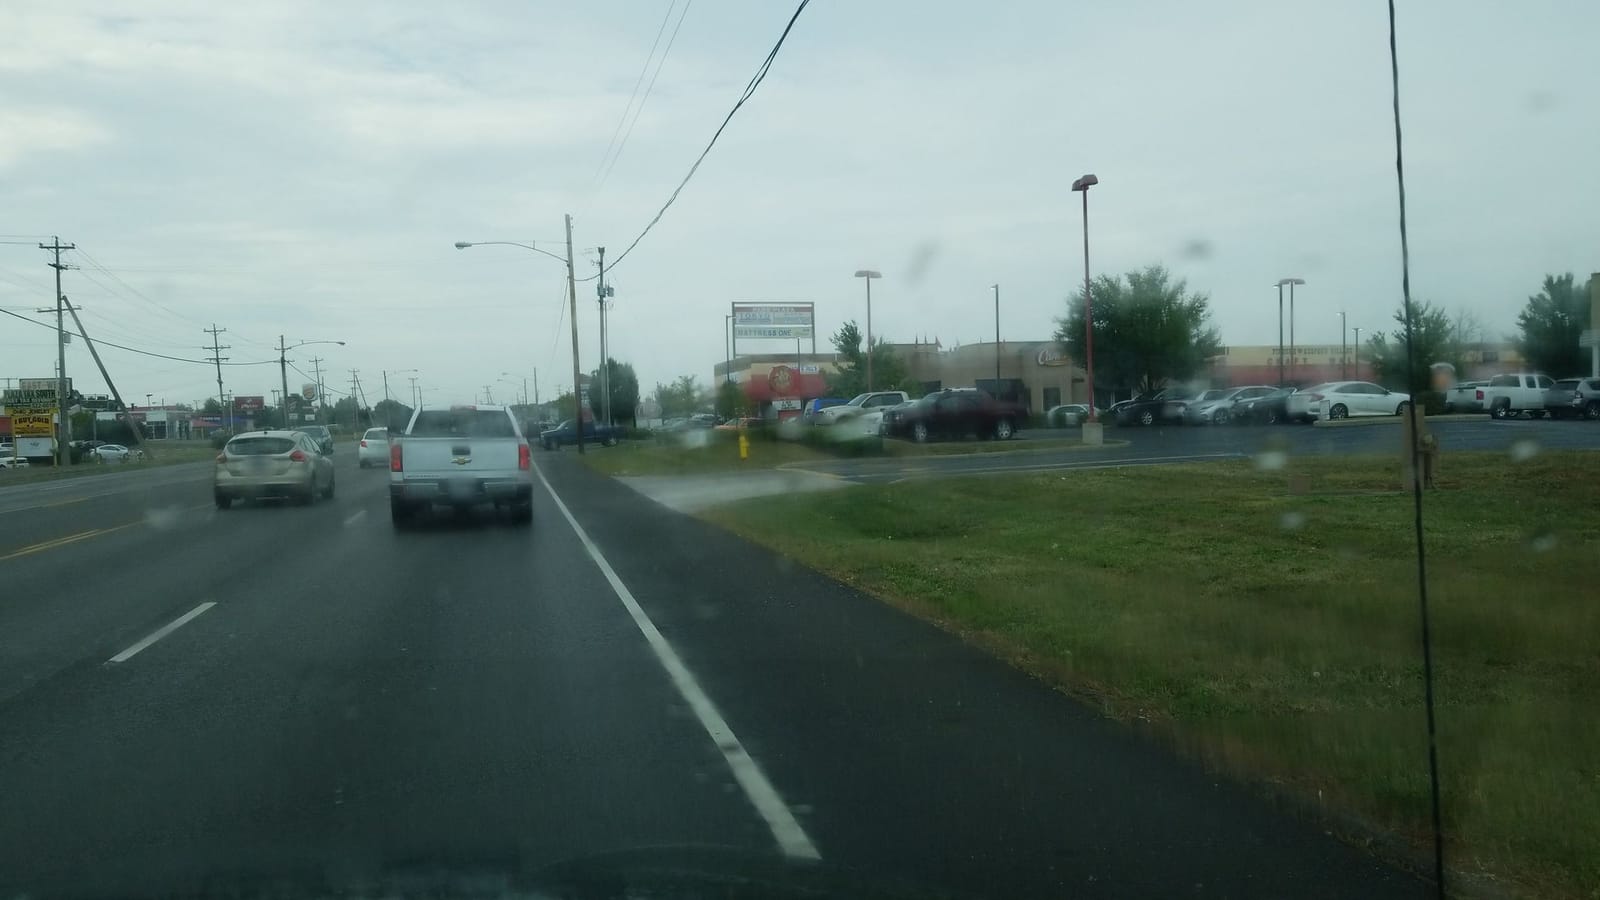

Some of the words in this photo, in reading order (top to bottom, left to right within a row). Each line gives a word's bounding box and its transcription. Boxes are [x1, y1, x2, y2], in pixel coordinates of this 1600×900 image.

[737, 329, 777, 337] MATTRESS
[779, 329, 793, 337] ONE
[32, 416, 49, 424] GOLD
